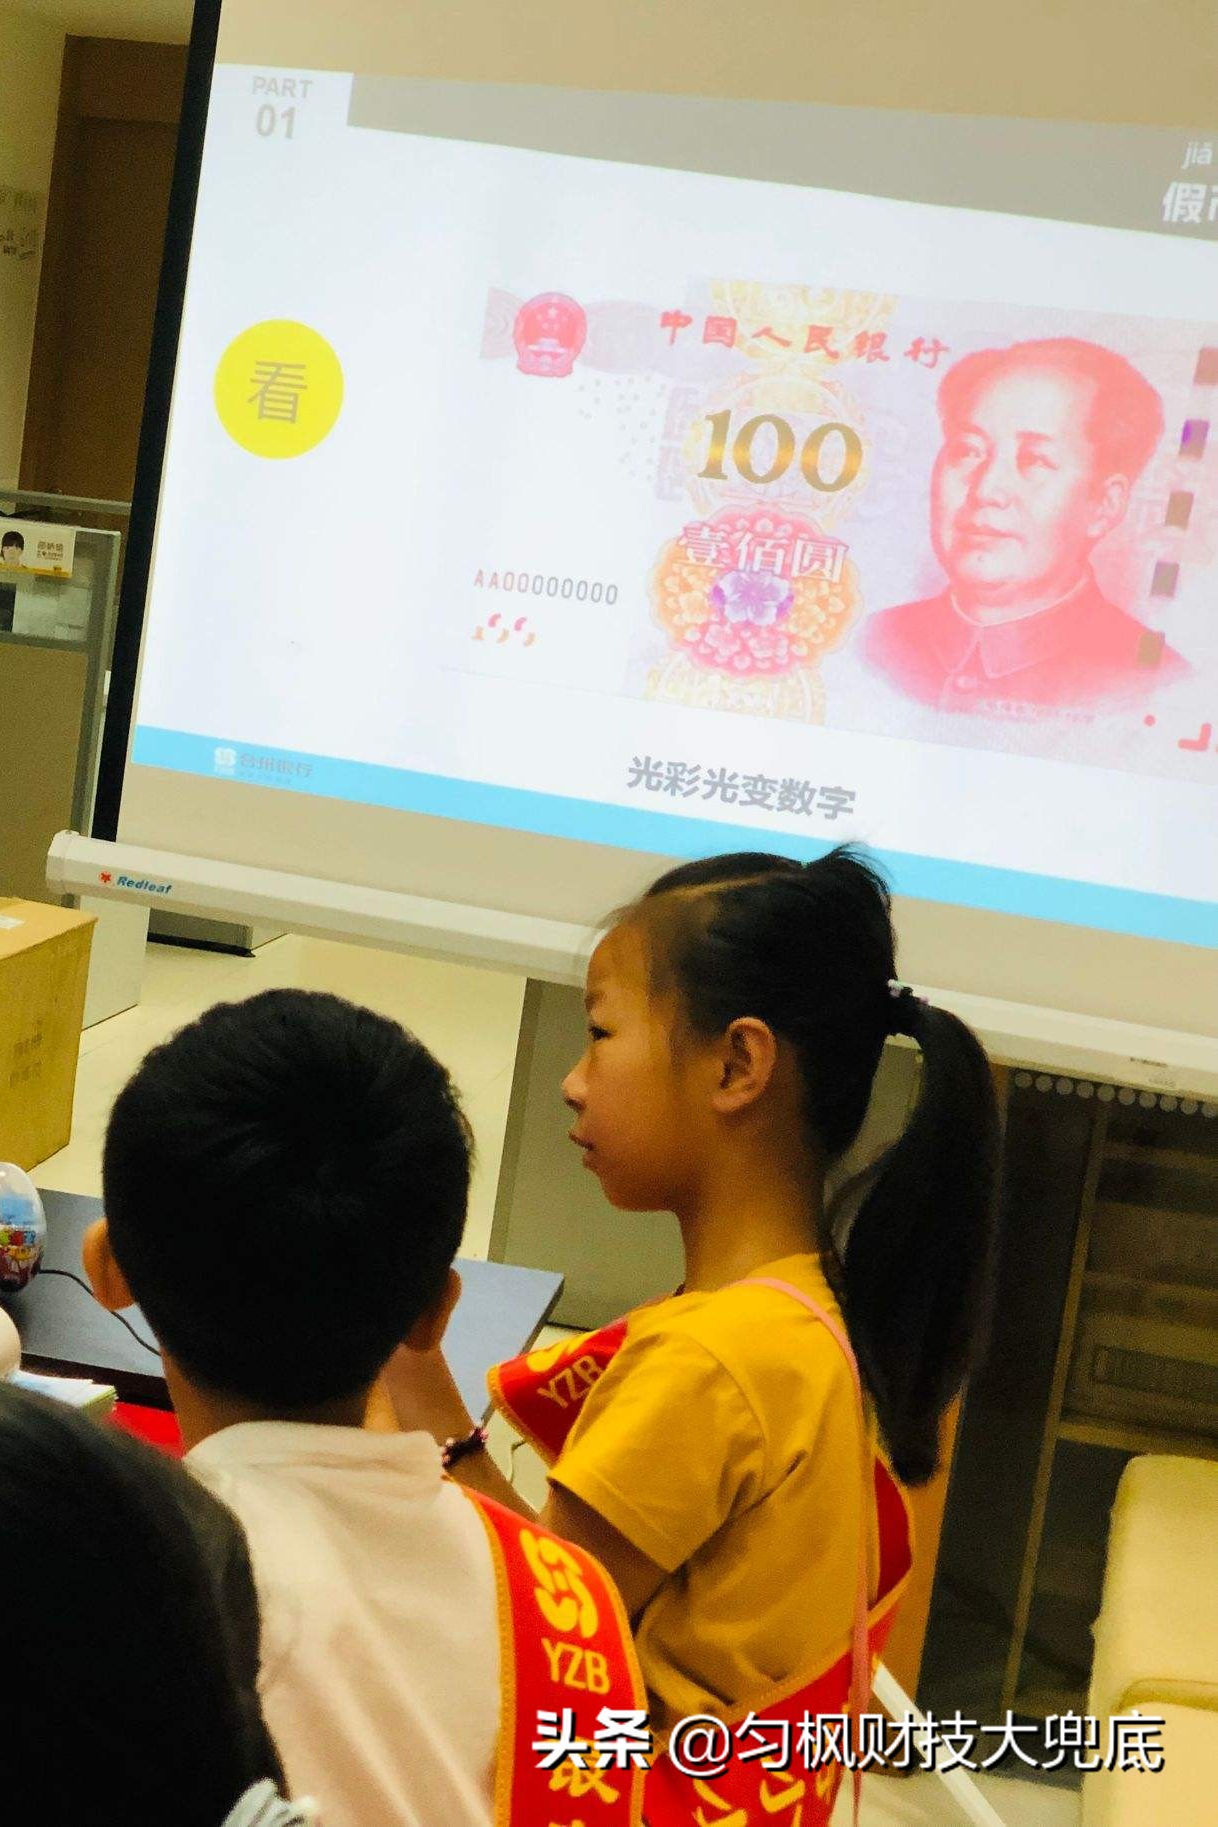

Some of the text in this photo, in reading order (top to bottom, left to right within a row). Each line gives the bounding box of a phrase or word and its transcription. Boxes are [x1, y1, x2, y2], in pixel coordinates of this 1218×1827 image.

[252, 76, 313, 99] PART
[256, 104, 296, 138] 01
[659, 309, 951, 370] 中国人民银行
[247, 360, 308, 424] 看
[697, 409, 863, 493] 100
[674, 526, 850, 585] 壹佰圆
[473, 568, 619, 606] AA00000000
[626, 755, 857, 821] 光彩光变数字
[116, 876, 172, 894] Redleaf
[537, 1355, 606, 1409] YZB
[541, 1638, 611, 1695] YZB
